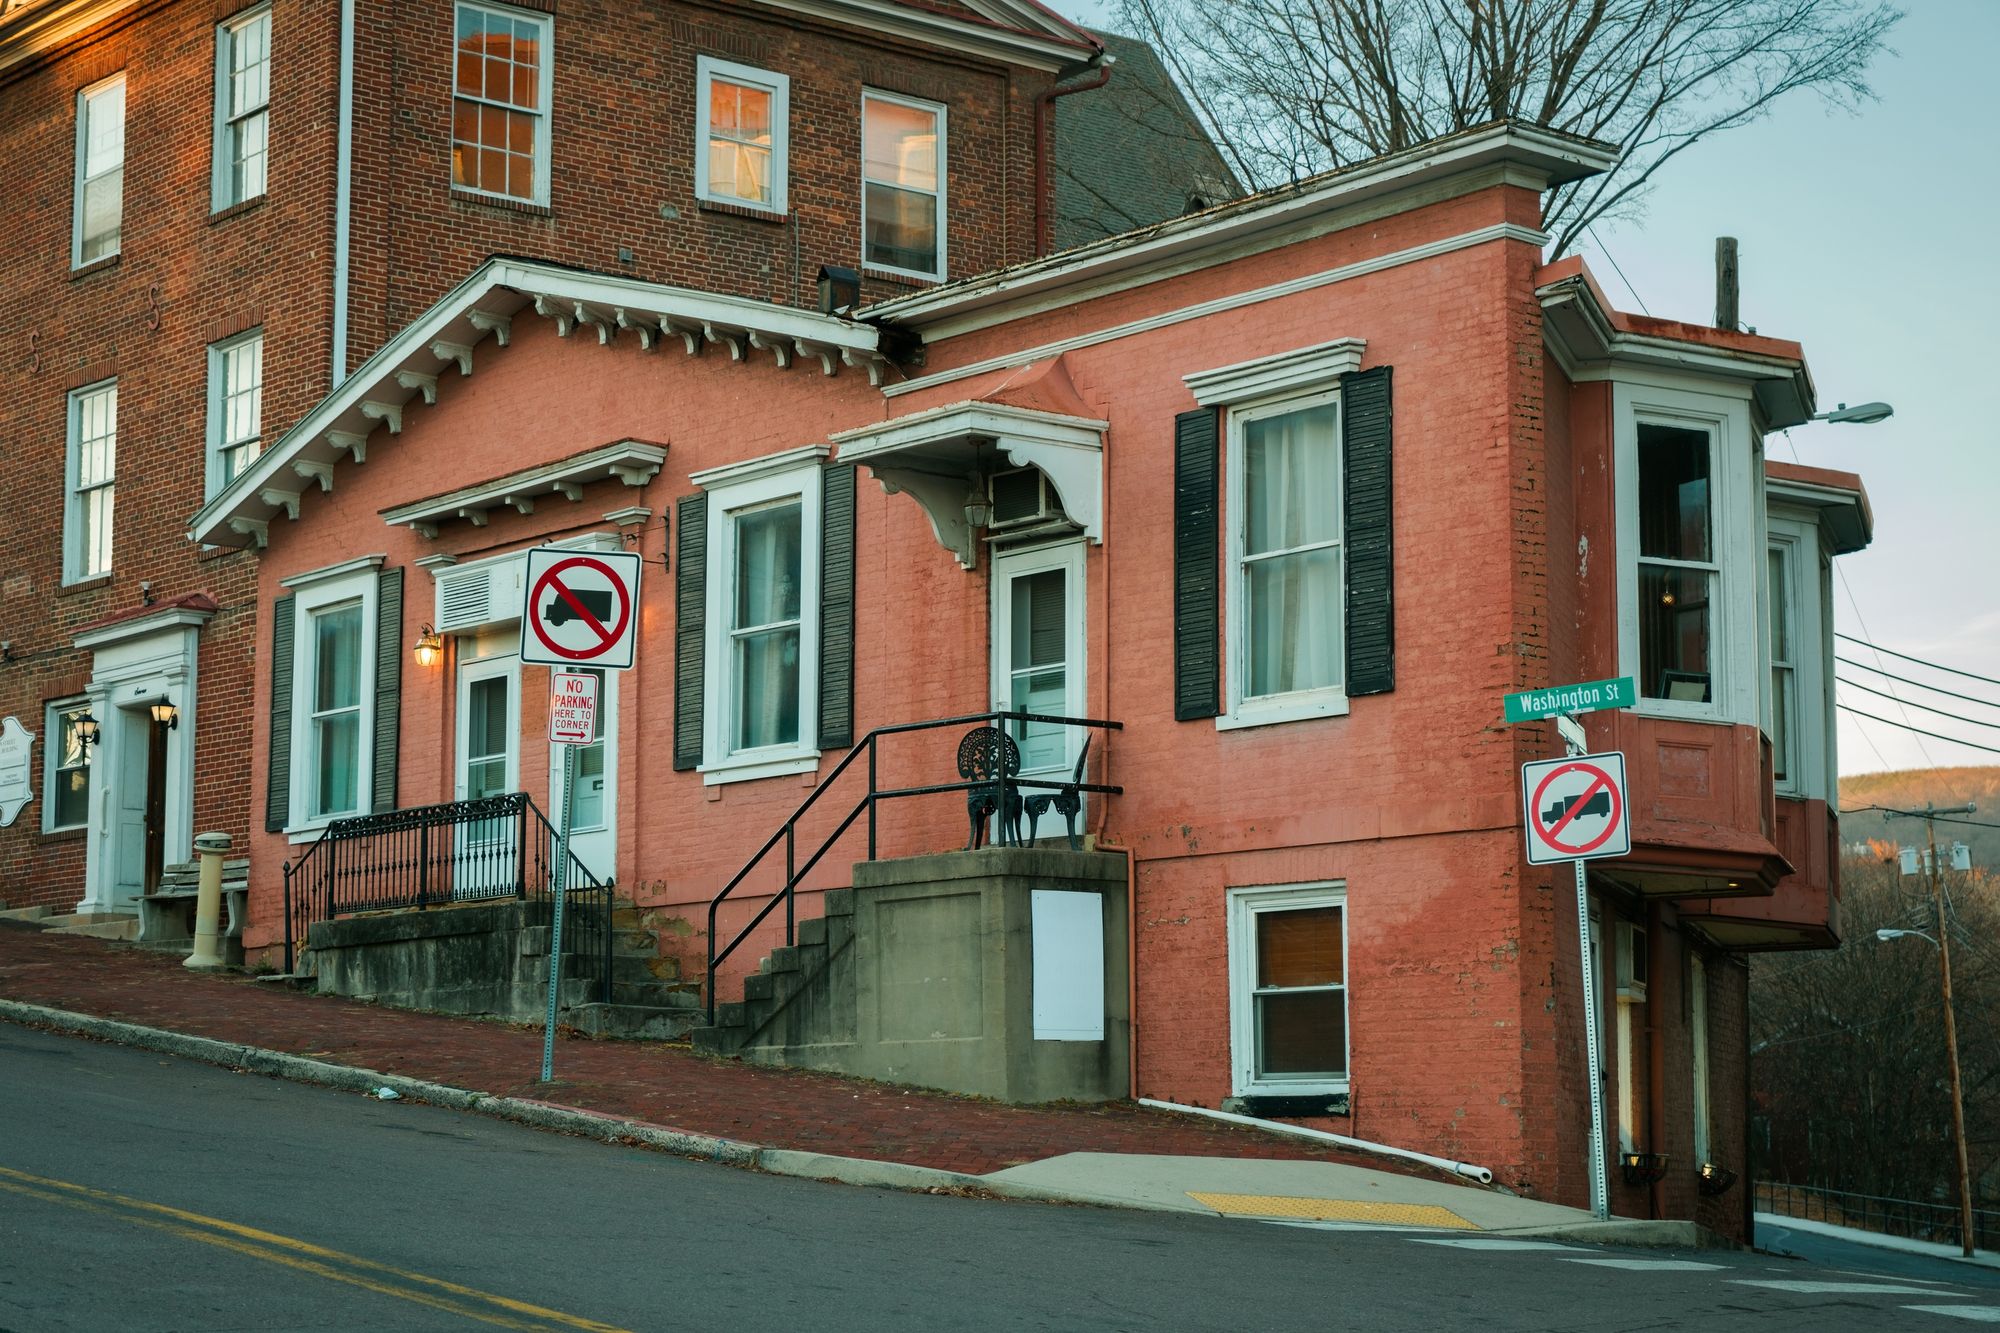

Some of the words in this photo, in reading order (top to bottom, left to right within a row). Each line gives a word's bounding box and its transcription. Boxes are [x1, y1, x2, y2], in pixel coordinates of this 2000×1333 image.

[566, 680, 583, 693] NO
[555, 694, 593, 710] PARKING
[1520, 687, 1600, 713] Washington
[1605, 684, 1620, 700] St
[554, 709, 575, 719] HERE
[581, 710, 591, 720] TO
[555, 720, 589, 730] CORNER
